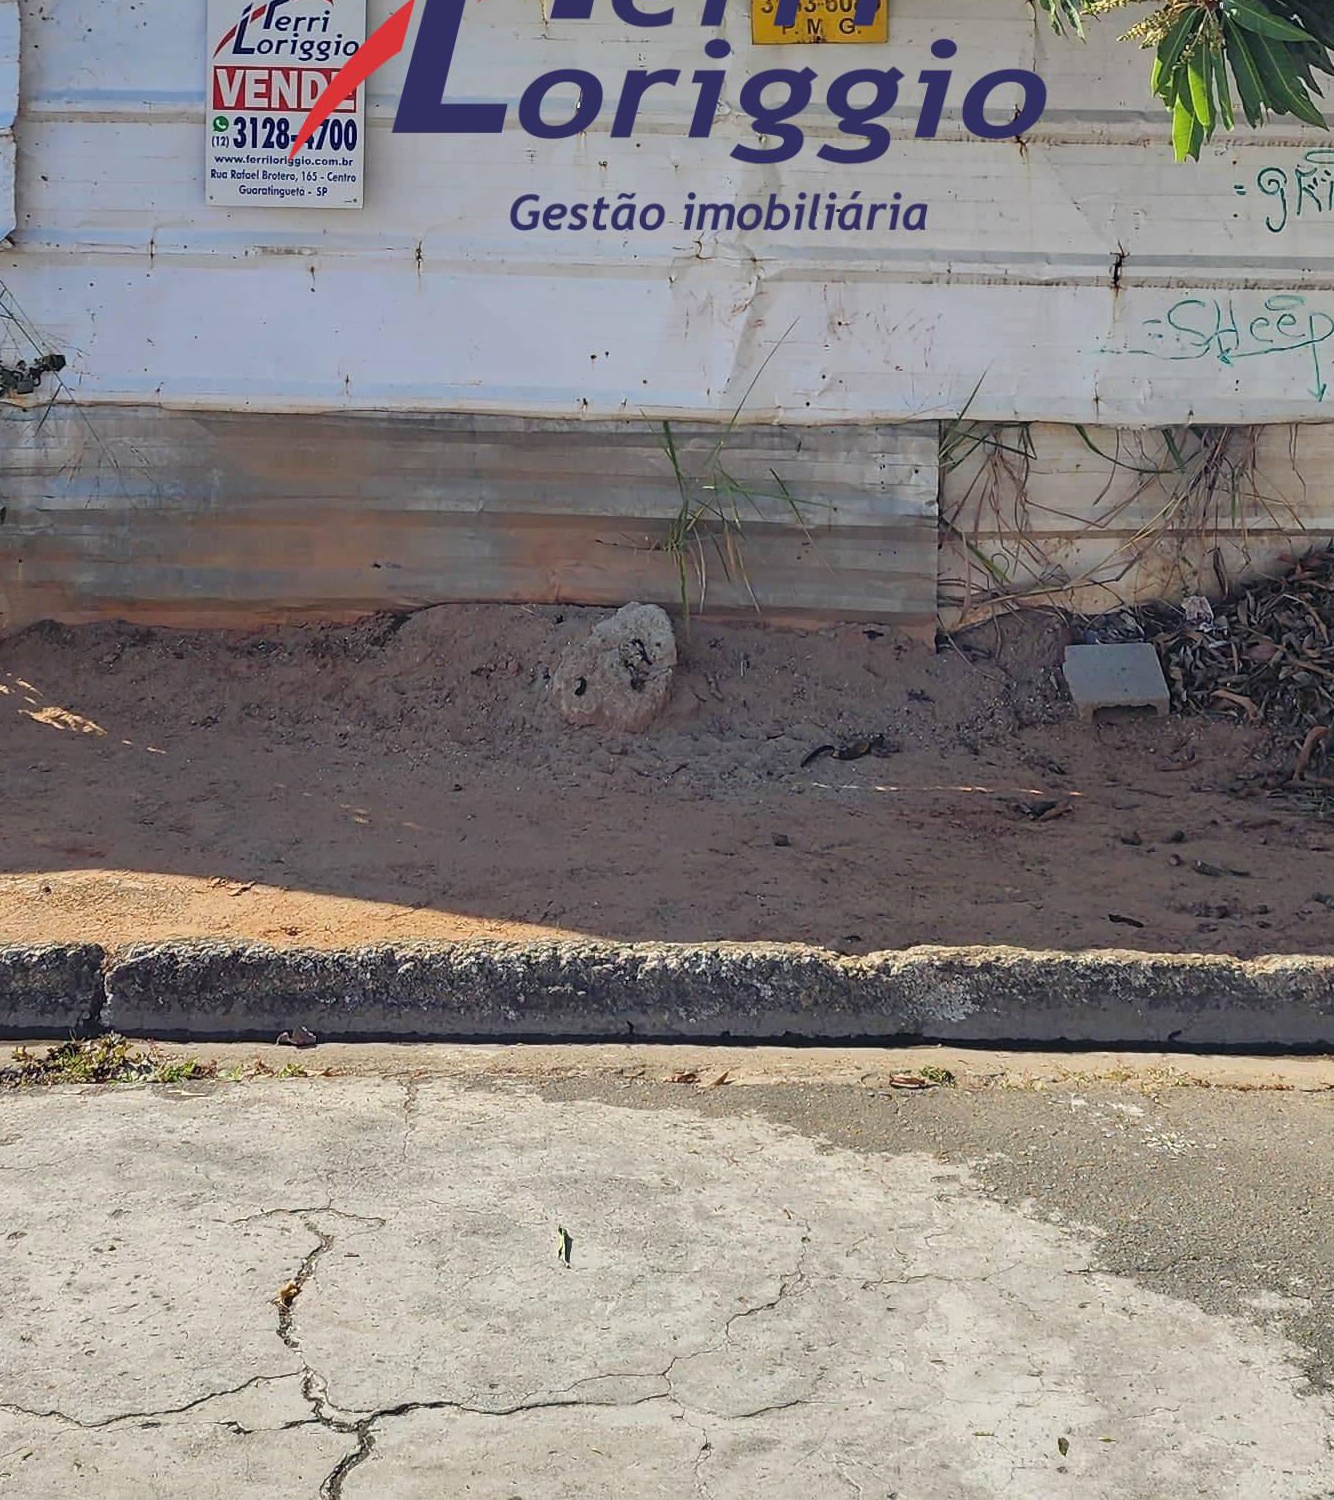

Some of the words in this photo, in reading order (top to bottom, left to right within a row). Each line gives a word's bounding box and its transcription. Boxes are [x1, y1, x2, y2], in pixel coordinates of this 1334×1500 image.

[232, 2, 359, 61] Loriggio
[211, 135, 229, 148] (12)
[214, 154, 354, 167] www.ferriloriggio.com.br
[210, 168, 228, 179] Rua
[230, 169, 260, 180] Rafael
[262, 170, 298, 182] Brotero,
[301, 171, 318, 182] 165
[327, 171, 357, 182] Centro
[316, 186, 328, 197] SP
